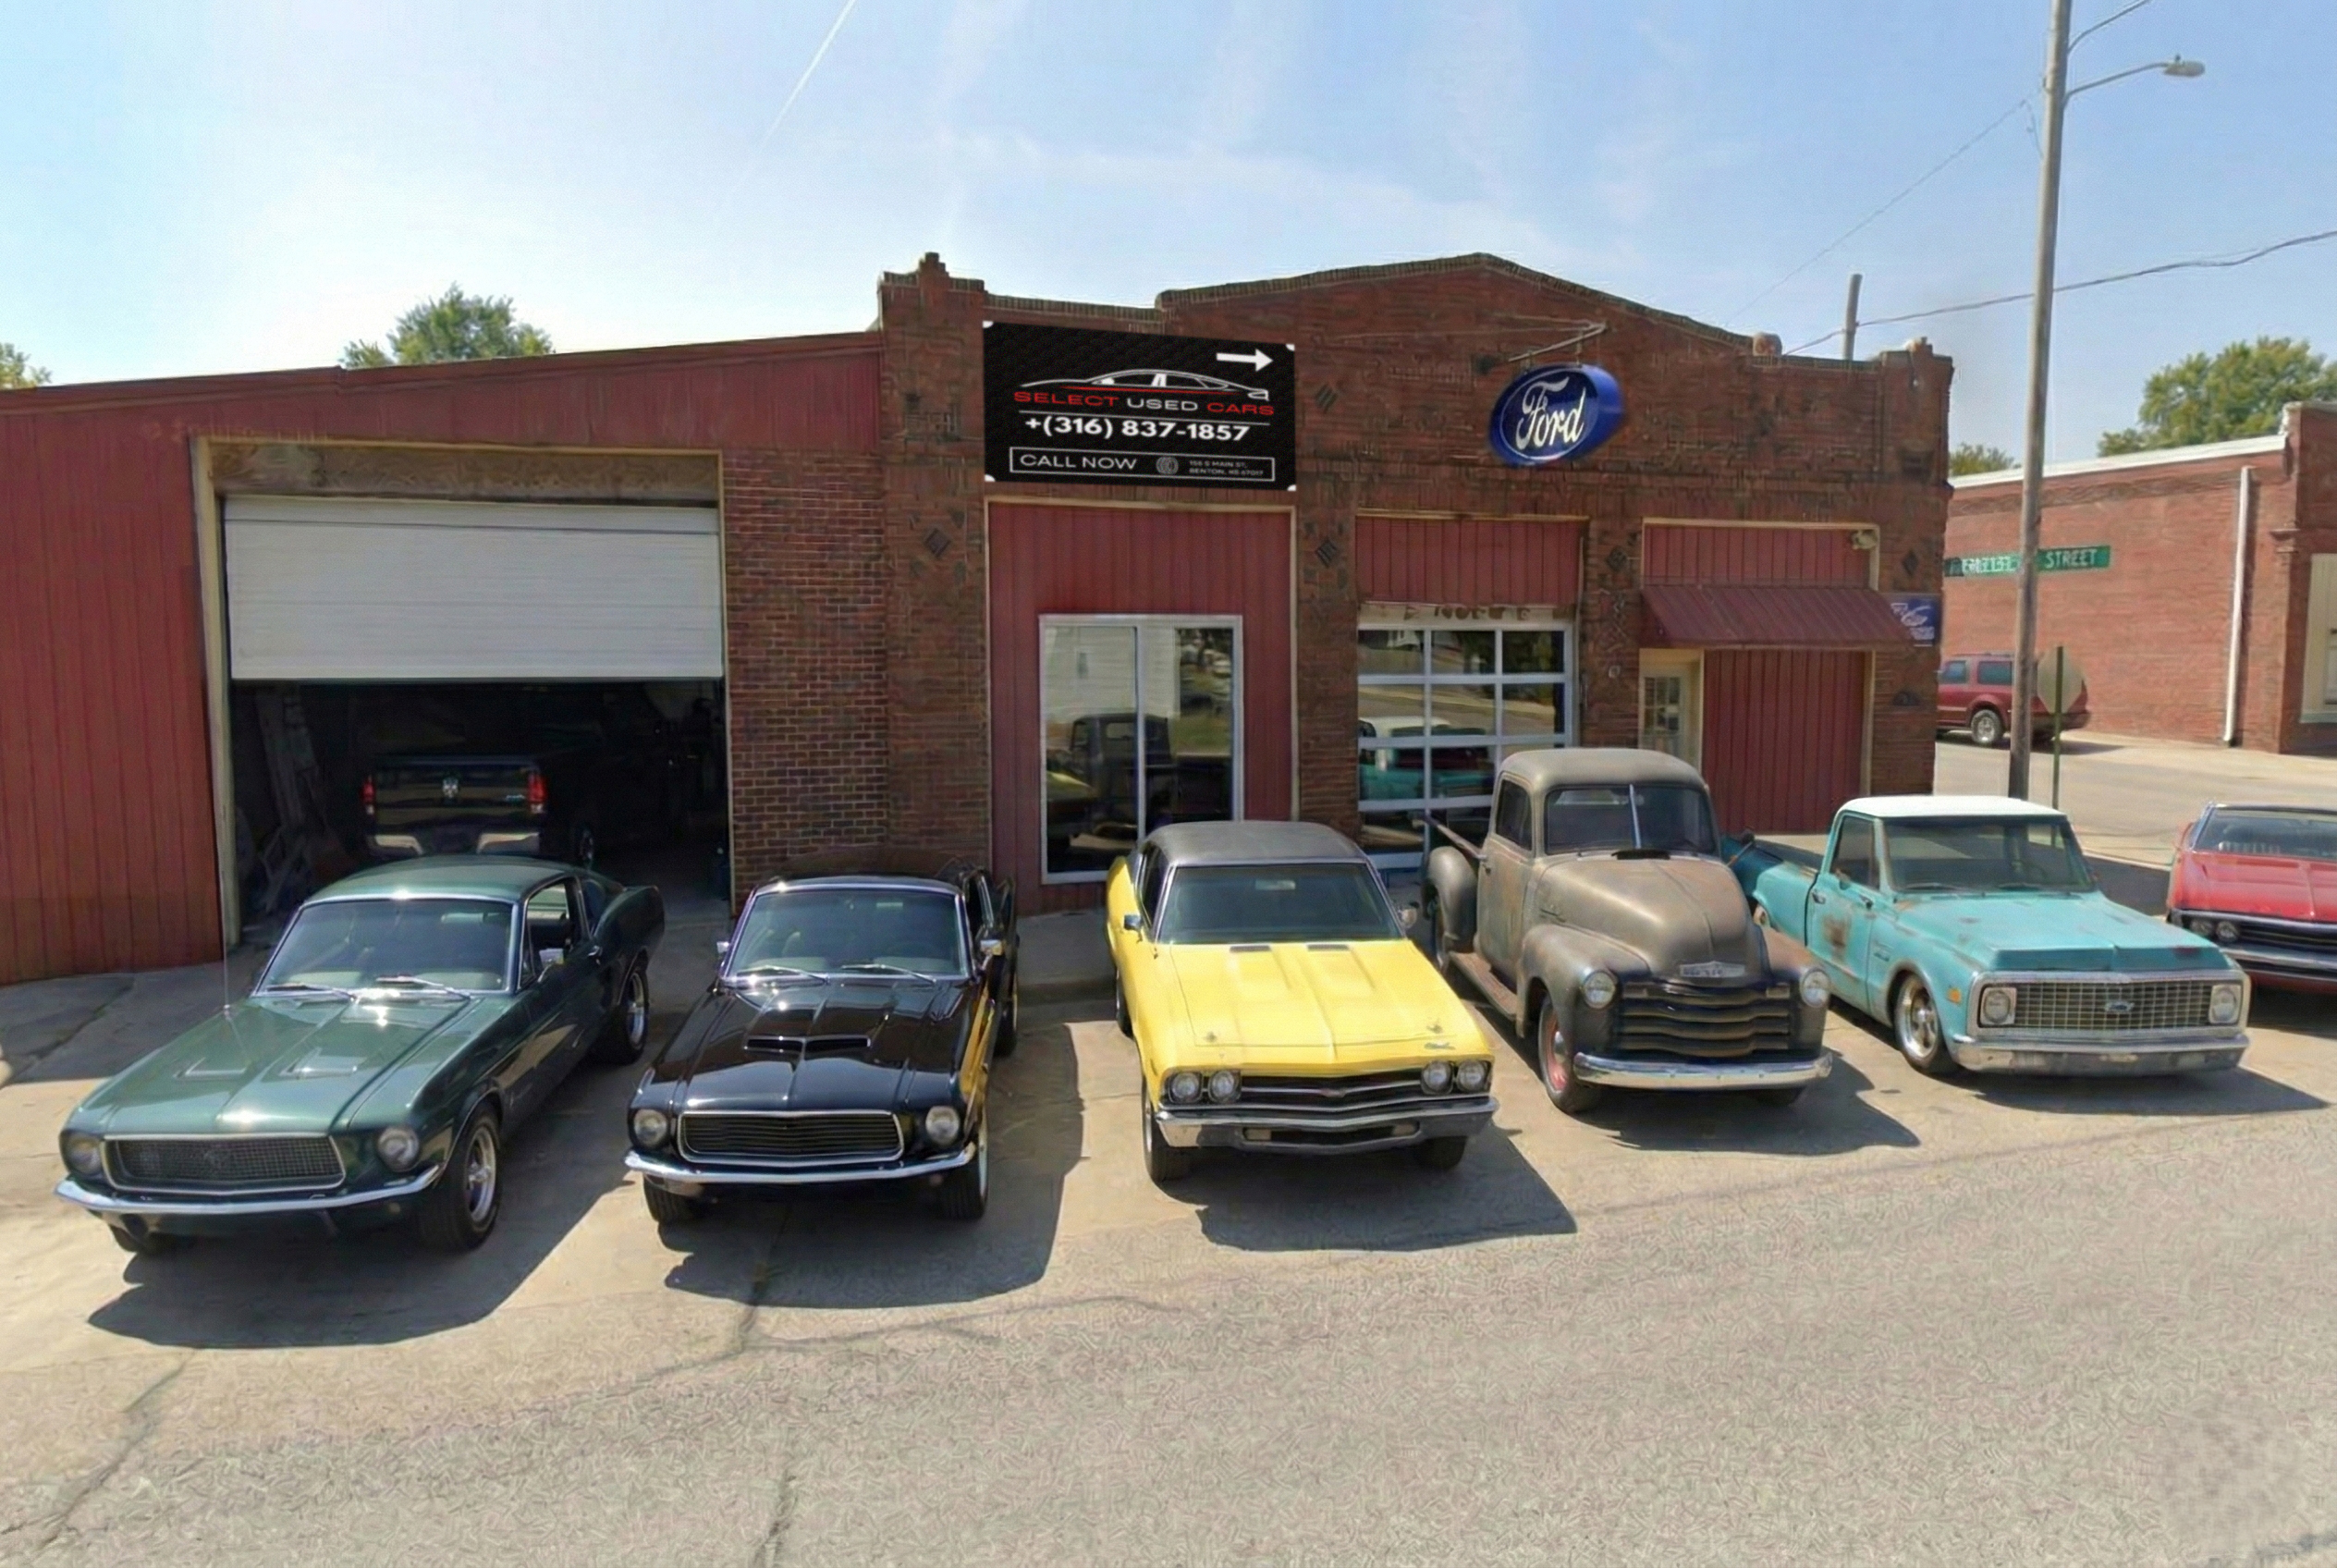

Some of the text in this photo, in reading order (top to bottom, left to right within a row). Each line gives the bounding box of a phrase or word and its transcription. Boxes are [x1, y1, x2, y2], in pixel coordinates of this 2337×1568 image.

[1014, 391, 1275, 416] SELECT USED CARS
[1515, 376, 1586, 450] Ford
[1024, 416, 1251, 442] +(316) 837-1857
[1020, 453, 1137, 471] CALL NOW
[2044, 548, 2098, 569] STREET
